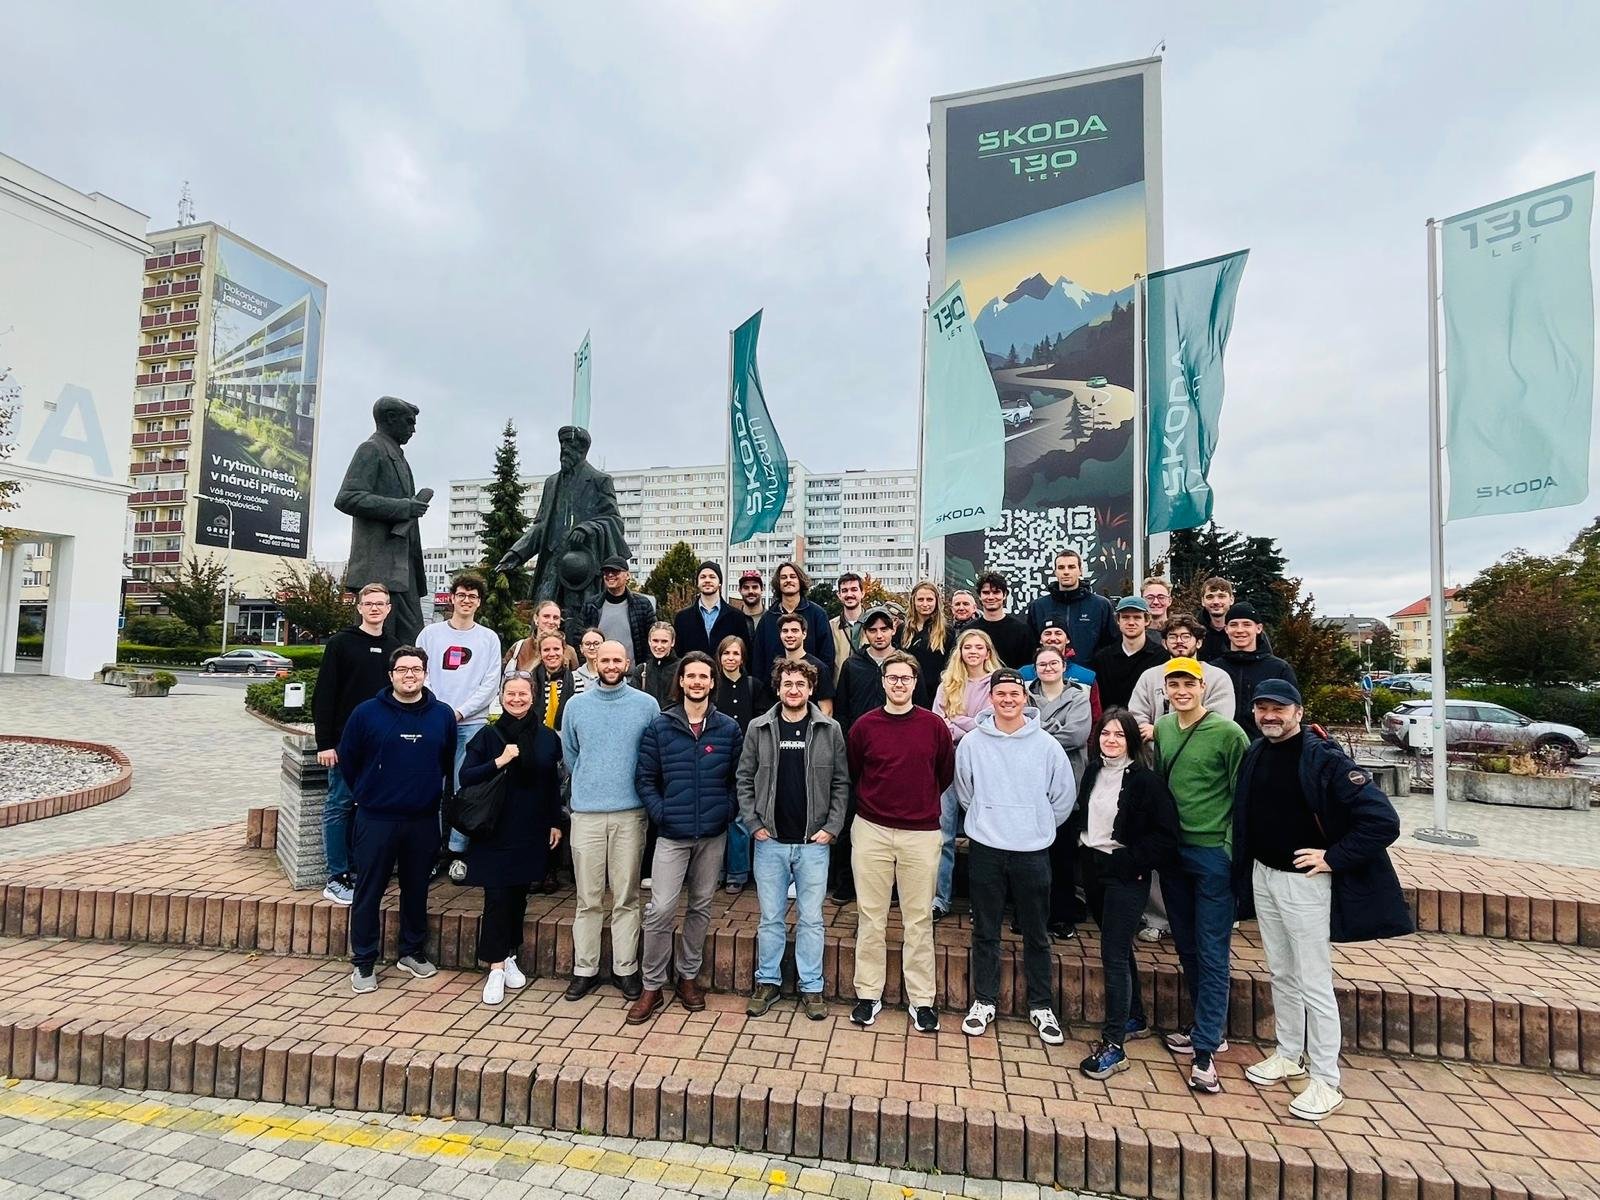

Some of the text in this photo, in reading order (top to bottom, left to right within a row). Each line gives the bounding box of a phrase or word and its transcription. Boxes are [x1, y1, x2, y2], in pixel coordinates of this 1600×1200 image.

[1009, 149, 1078, 175] 130
[1028, 171, 1062, 182] LET
[1460, 194, 1573, 250] 130
[1491, 233, 1542, 258] LET
[222, 291, 263, 316] jaro 2026
[933, 295, 966, 334] 130
[211, 454, 298, 486] V rytmu města,
[748, 416, 779, 509] Muzeum
[210, 471, 303, 502] v náručí přírody.
[224, 489, 242, 501] nový
